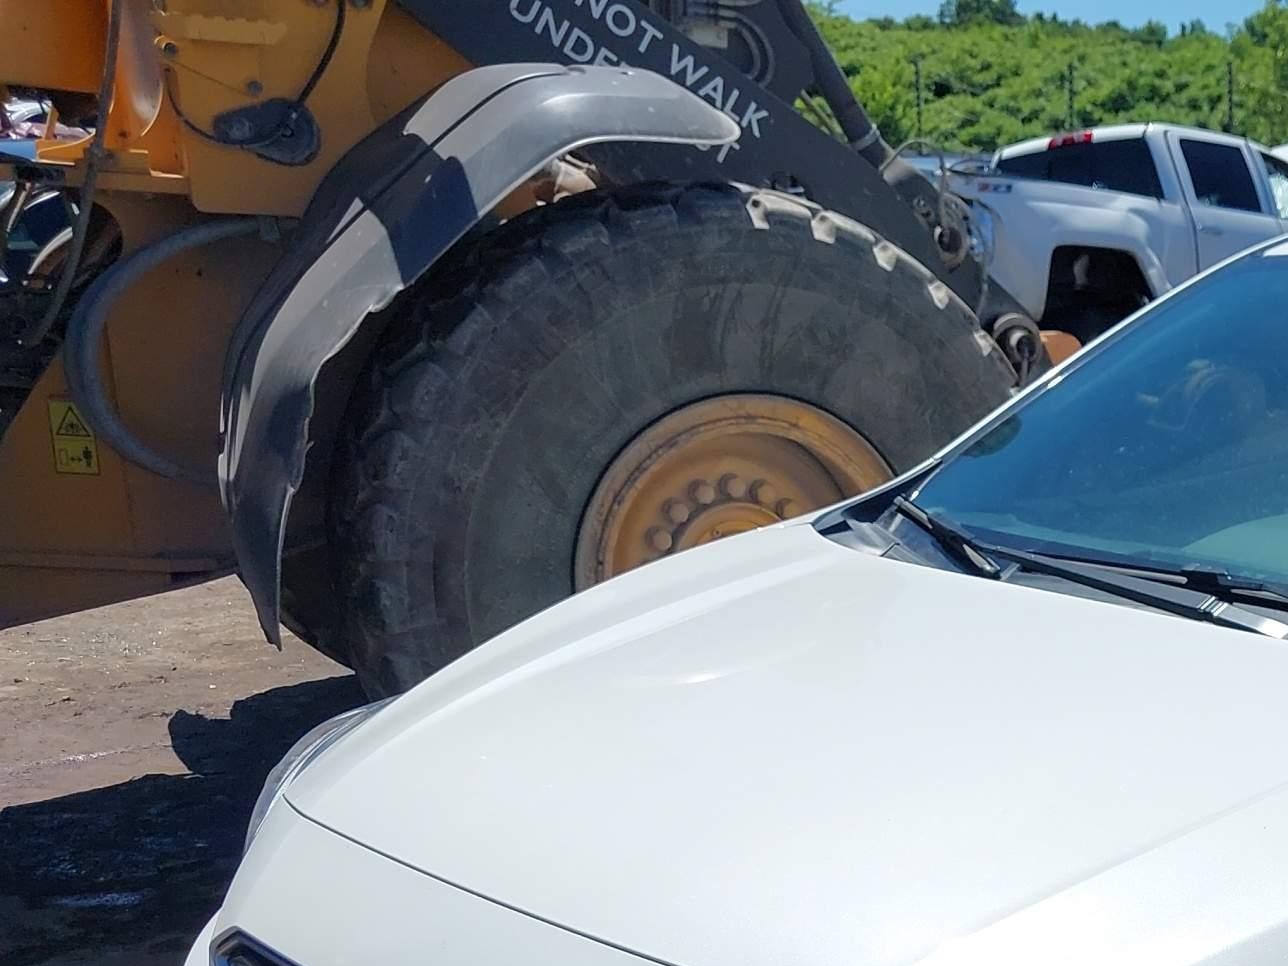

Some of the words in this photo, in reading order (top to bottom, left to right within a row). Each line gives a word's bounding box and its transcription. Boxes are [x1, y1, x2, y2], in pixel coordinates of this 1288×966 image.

[509, 0, 631, 67] UNDE
[575, 0, 664, 53] NOT
[669, 43, 769, 138] WALK
